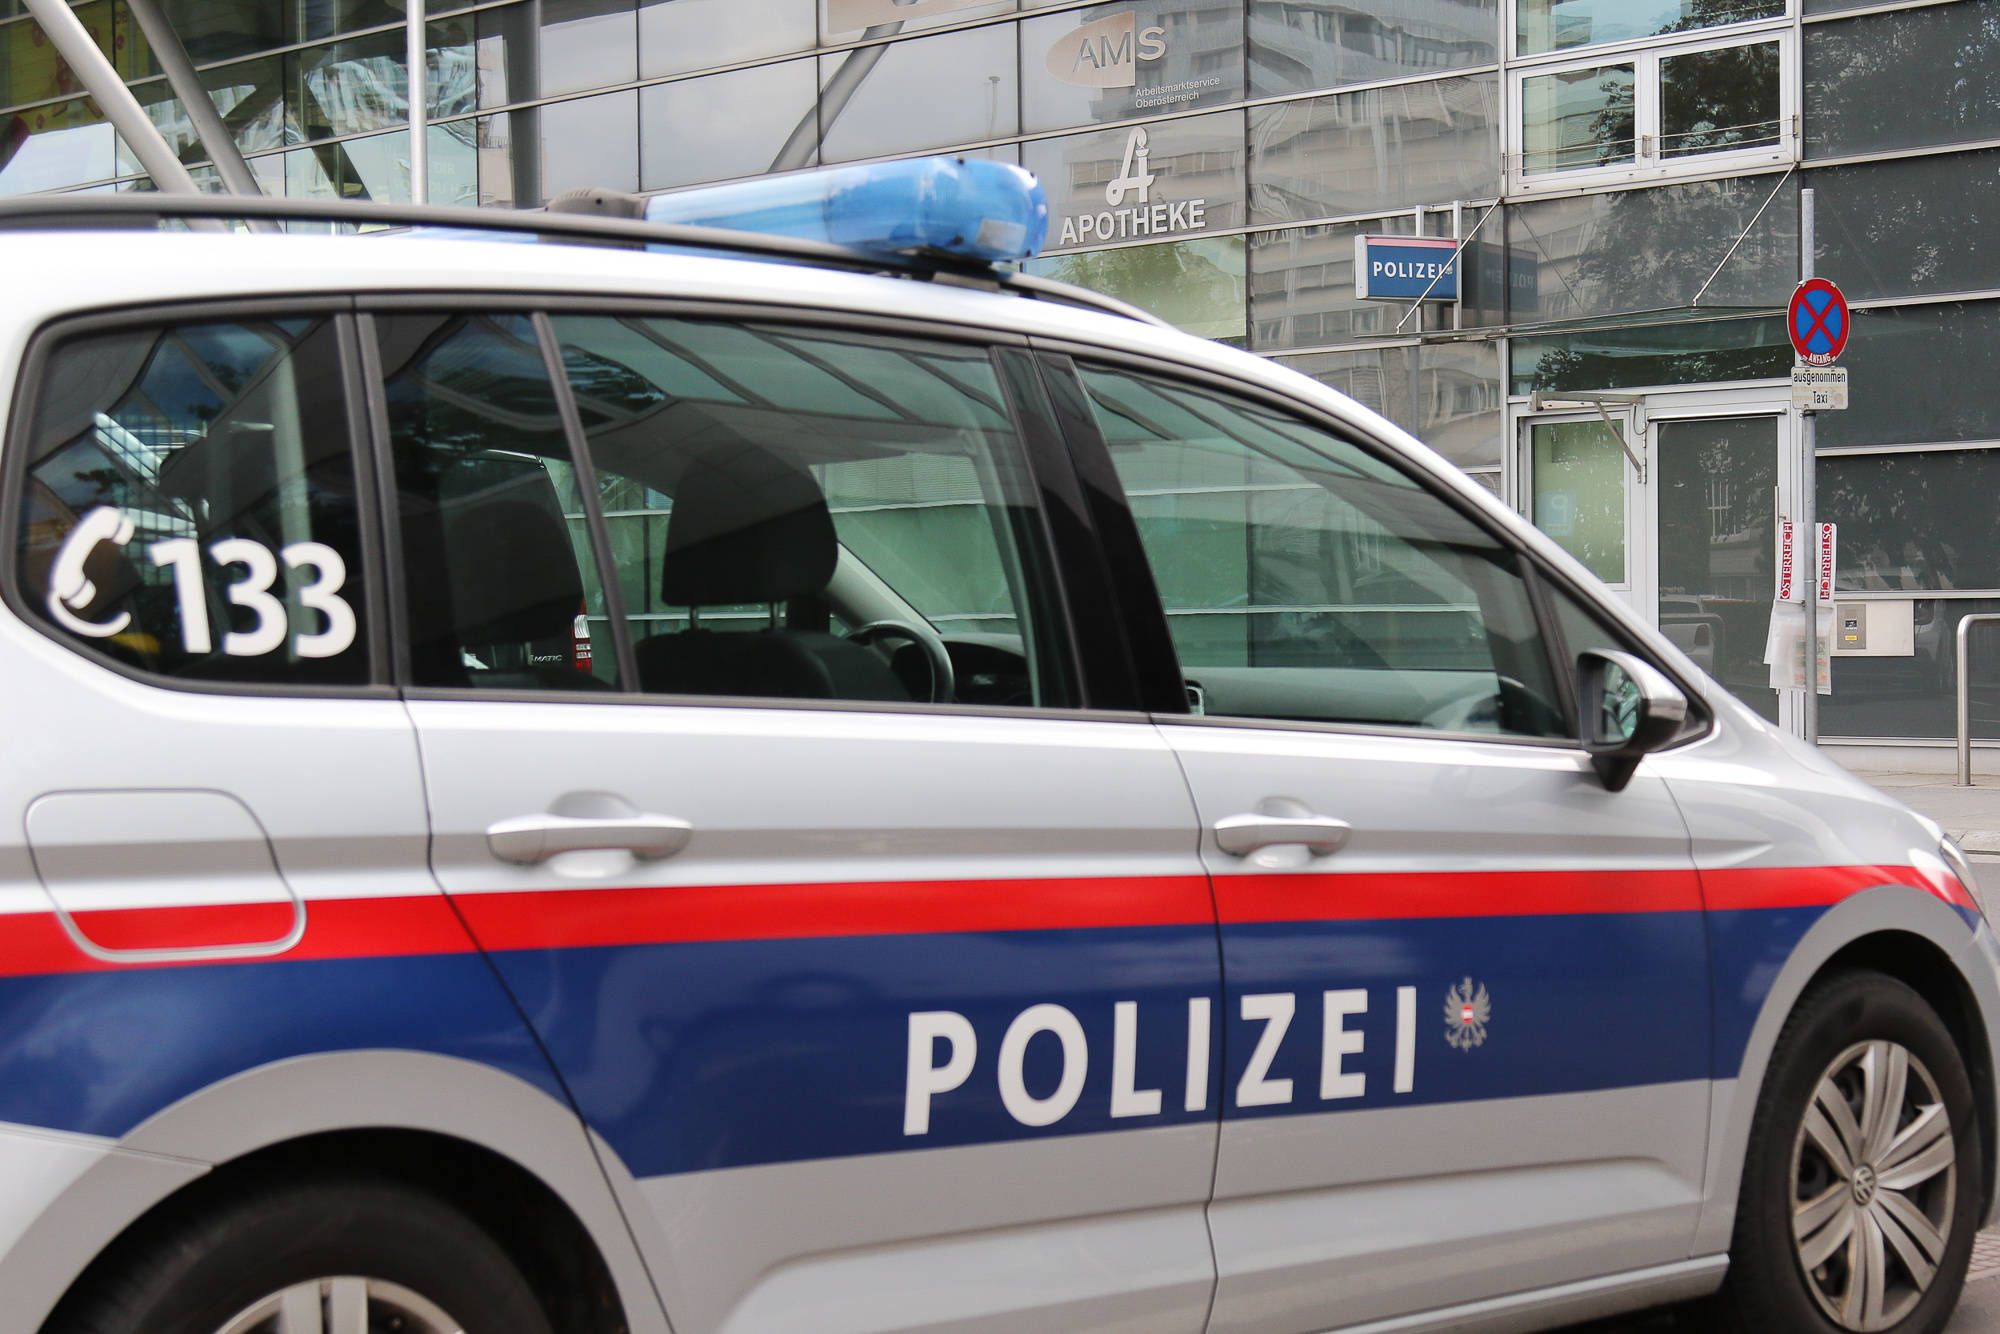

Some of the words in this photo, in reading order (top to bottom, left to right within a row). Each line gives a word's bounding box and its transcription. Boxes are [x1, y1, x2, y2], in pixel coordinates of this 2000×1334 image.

[1073, 26, 1166, 73] AMS
[1135, 76, 1221, 98] Arbeitsmarktservice
[1135, 90, 1200, 109] Oberösterreich
[1059, 198, 1206, 246] APOTHEKE
[1373, 261, 1444, 280] POLIZEI
[1808, 352, 1831, 364] ANFANG
[1793, 372, 1846, 385] ausgenommen
[1813, 391, 1828, 404] Taxi
[150, 538, 357, 658] 133
[903, 985, 1417, 1136] POLIZEI
